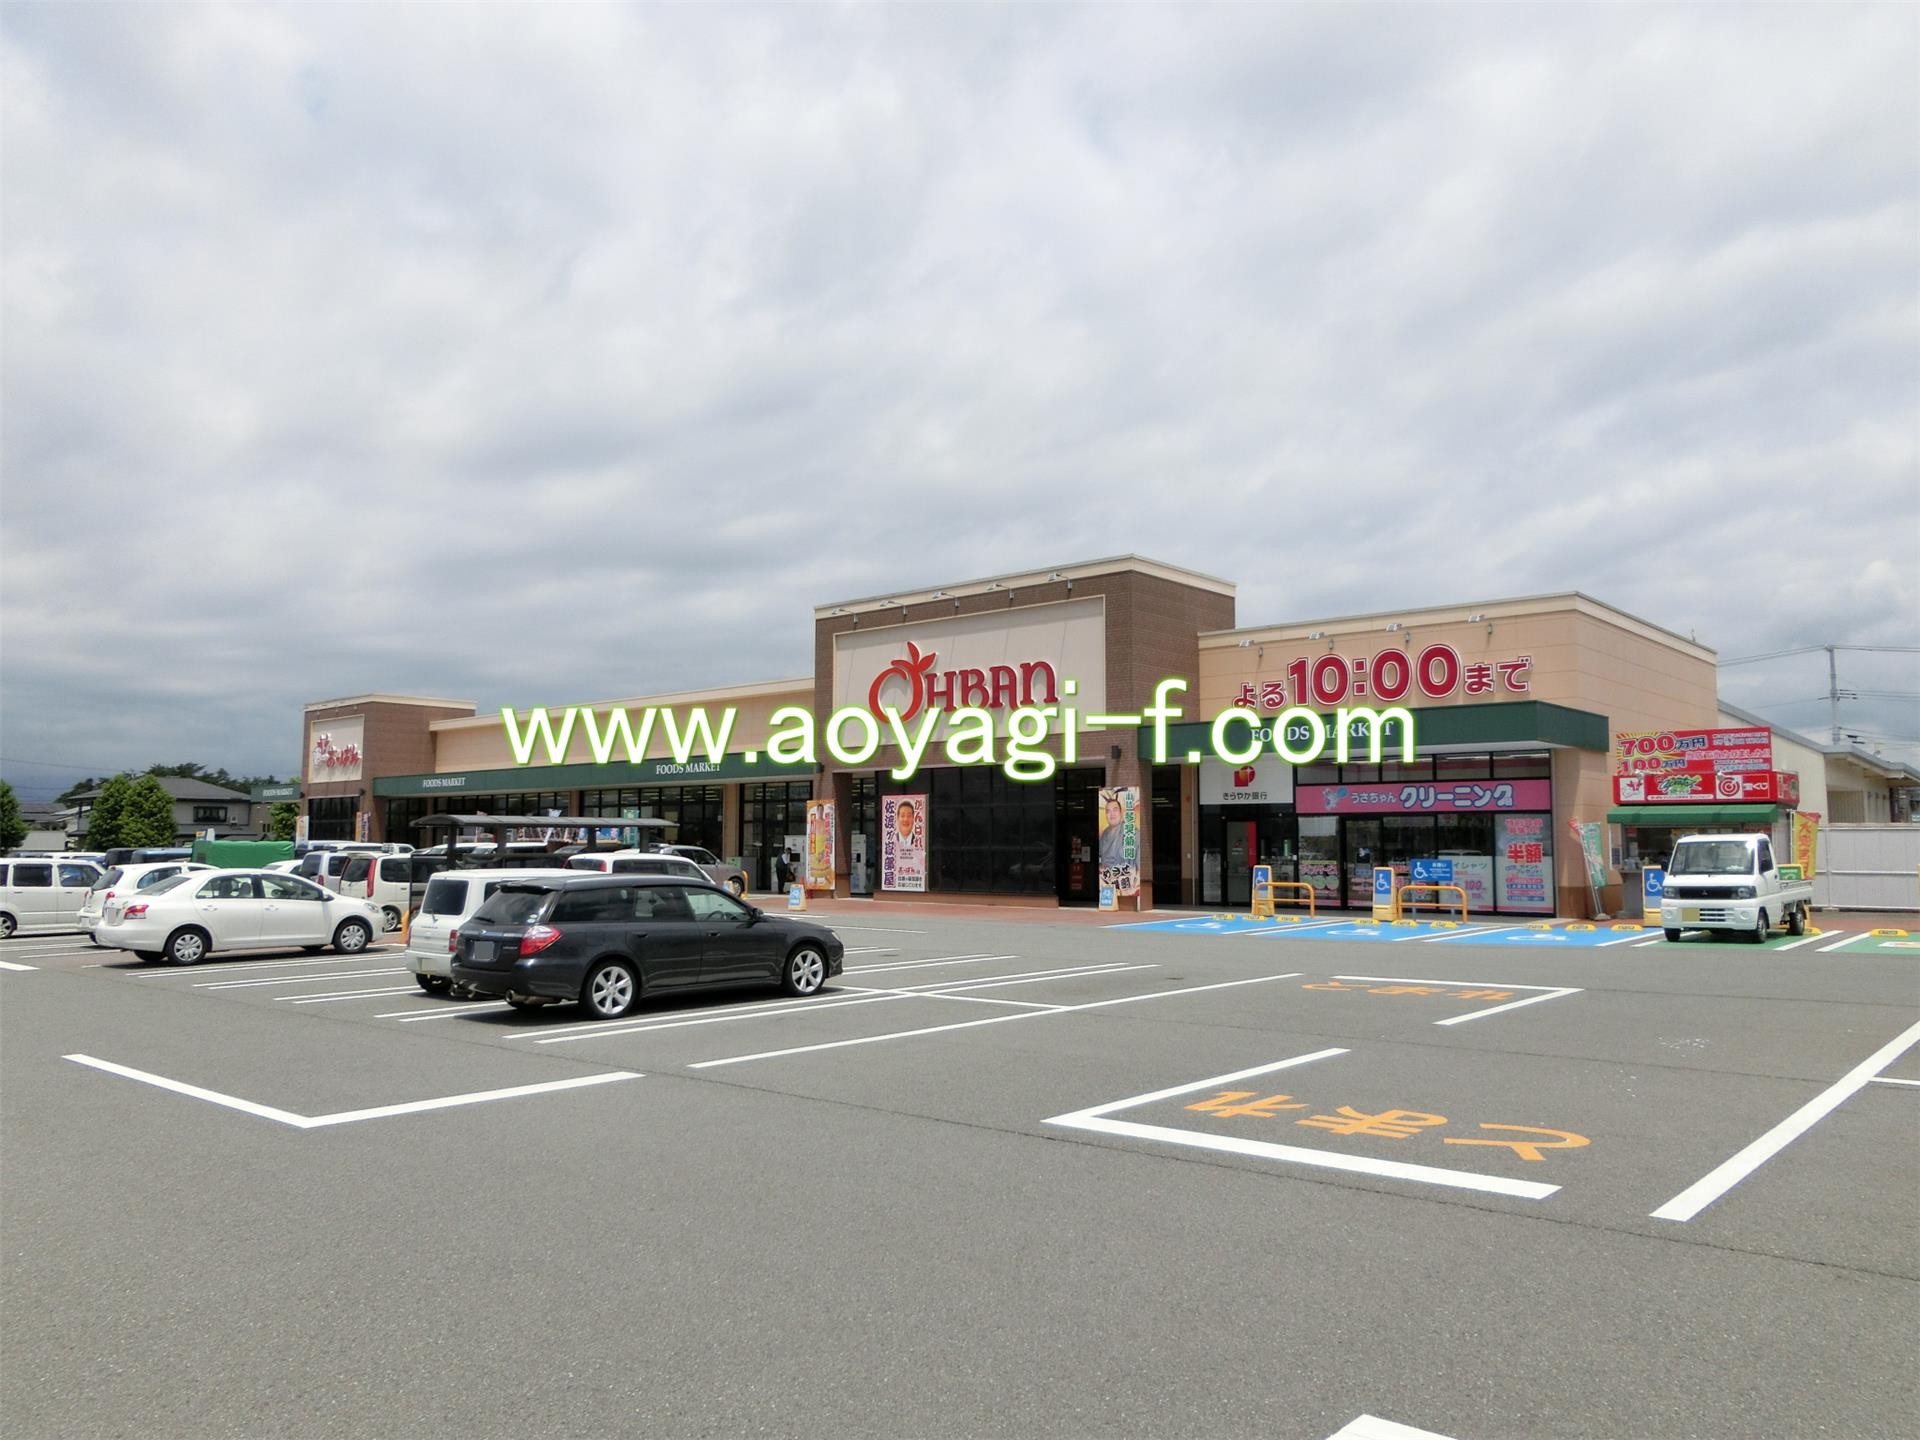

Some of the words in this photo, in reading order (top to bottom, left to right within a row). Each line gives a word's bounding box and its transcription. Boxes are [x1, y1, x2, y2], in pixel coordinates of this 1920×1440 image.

[1231, 643, 1533, 710] よる10:00まで
[1251, 726, 1310, 743] FODS
[1322, 720, 1395, 738] RKT
[656, 764, 684, 775] FOODS
[685, 762, 720, 774] MARKET
[1399, 784, 1514, 809] クリーニング
[1507, 843, 1543, 864] 半額
[1183, 1090, 1592, 1162] とまれ
